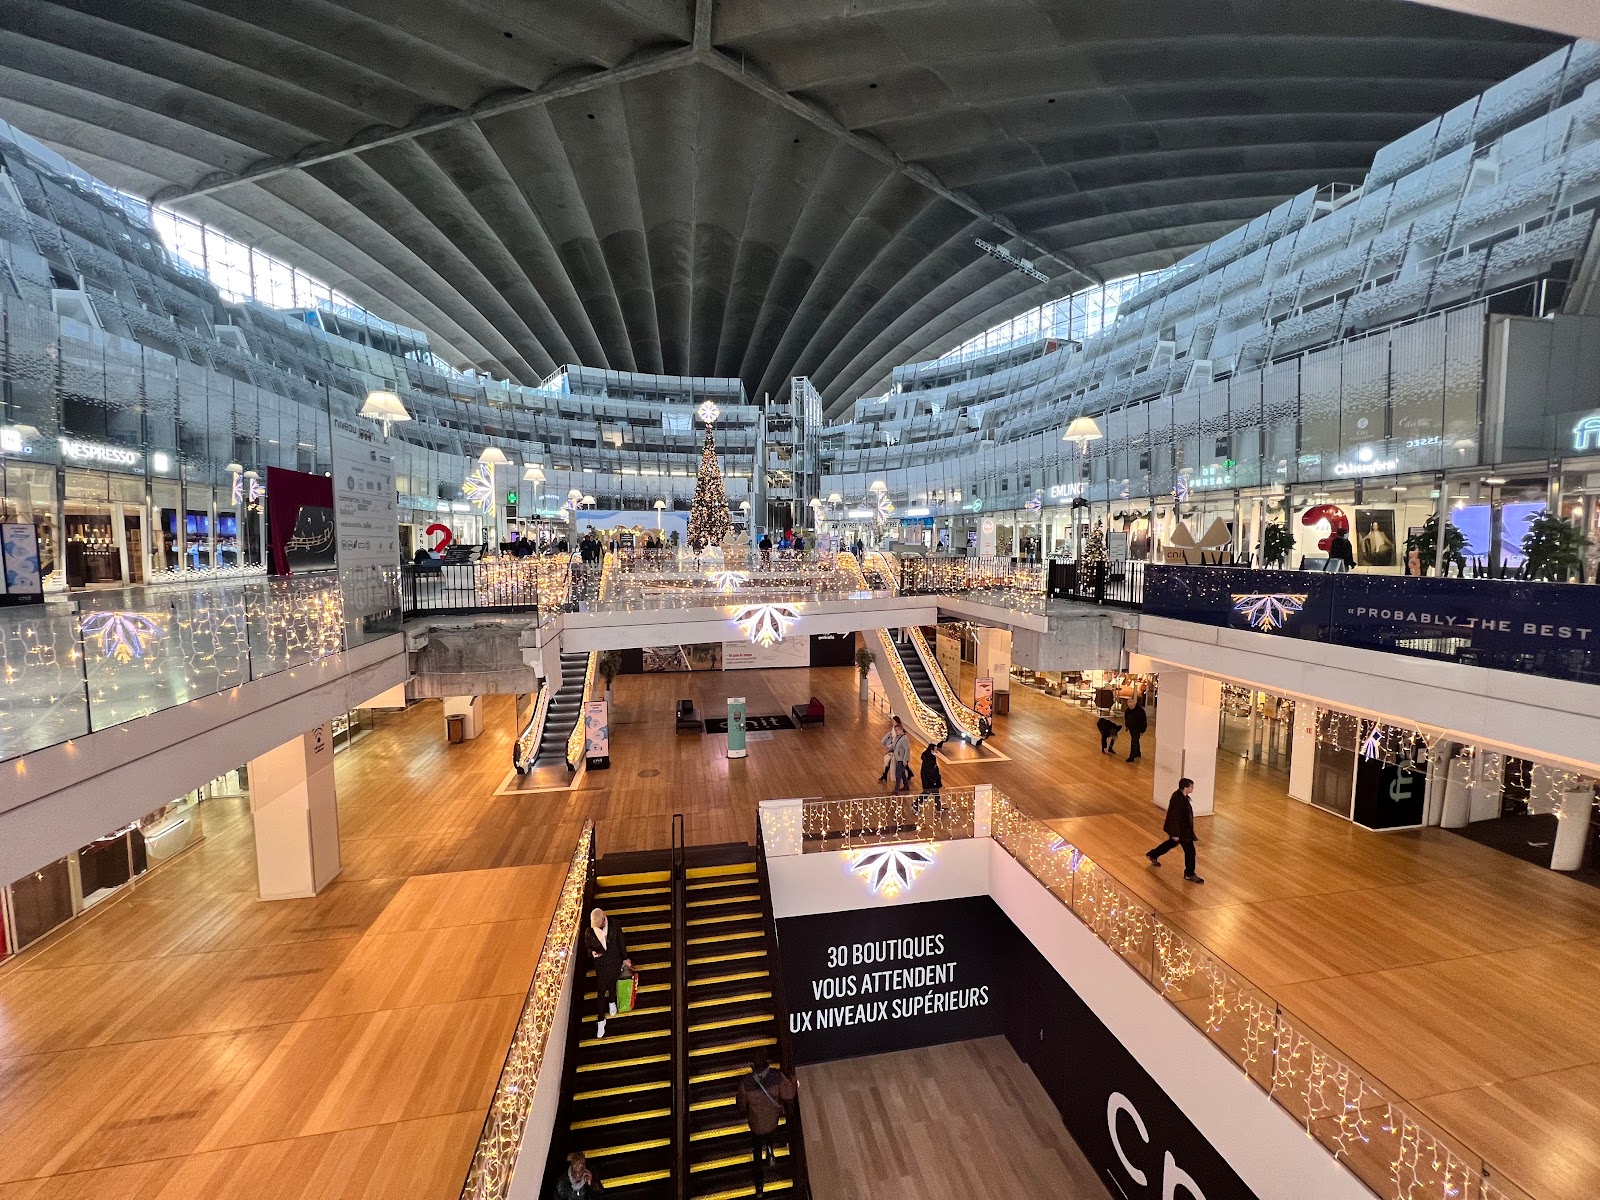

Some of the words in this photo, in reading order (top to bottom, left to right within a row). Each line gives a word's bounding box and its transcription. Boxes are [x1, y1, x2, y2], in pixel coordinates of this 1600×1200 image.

[58, 436, 136, 465] NESPRESSO
[1202, 467, 1217, 476] DE
[1167, 550, 1184, 558] cni
[1467, 617, 1511, 632] THE
[1523, 623, 1592, 640] BEST
[827, 945, 848, 969] 30
[852, 934, 945, 965] BOUTIQUES
[812, 974, 857, 1001] VOUS
[860, 961, 957, 995] ATTENDENT
[816, 1000, 889, 1030] NIVEAUX
[891, 985, 989, 1019] SUPÉRIEURS
